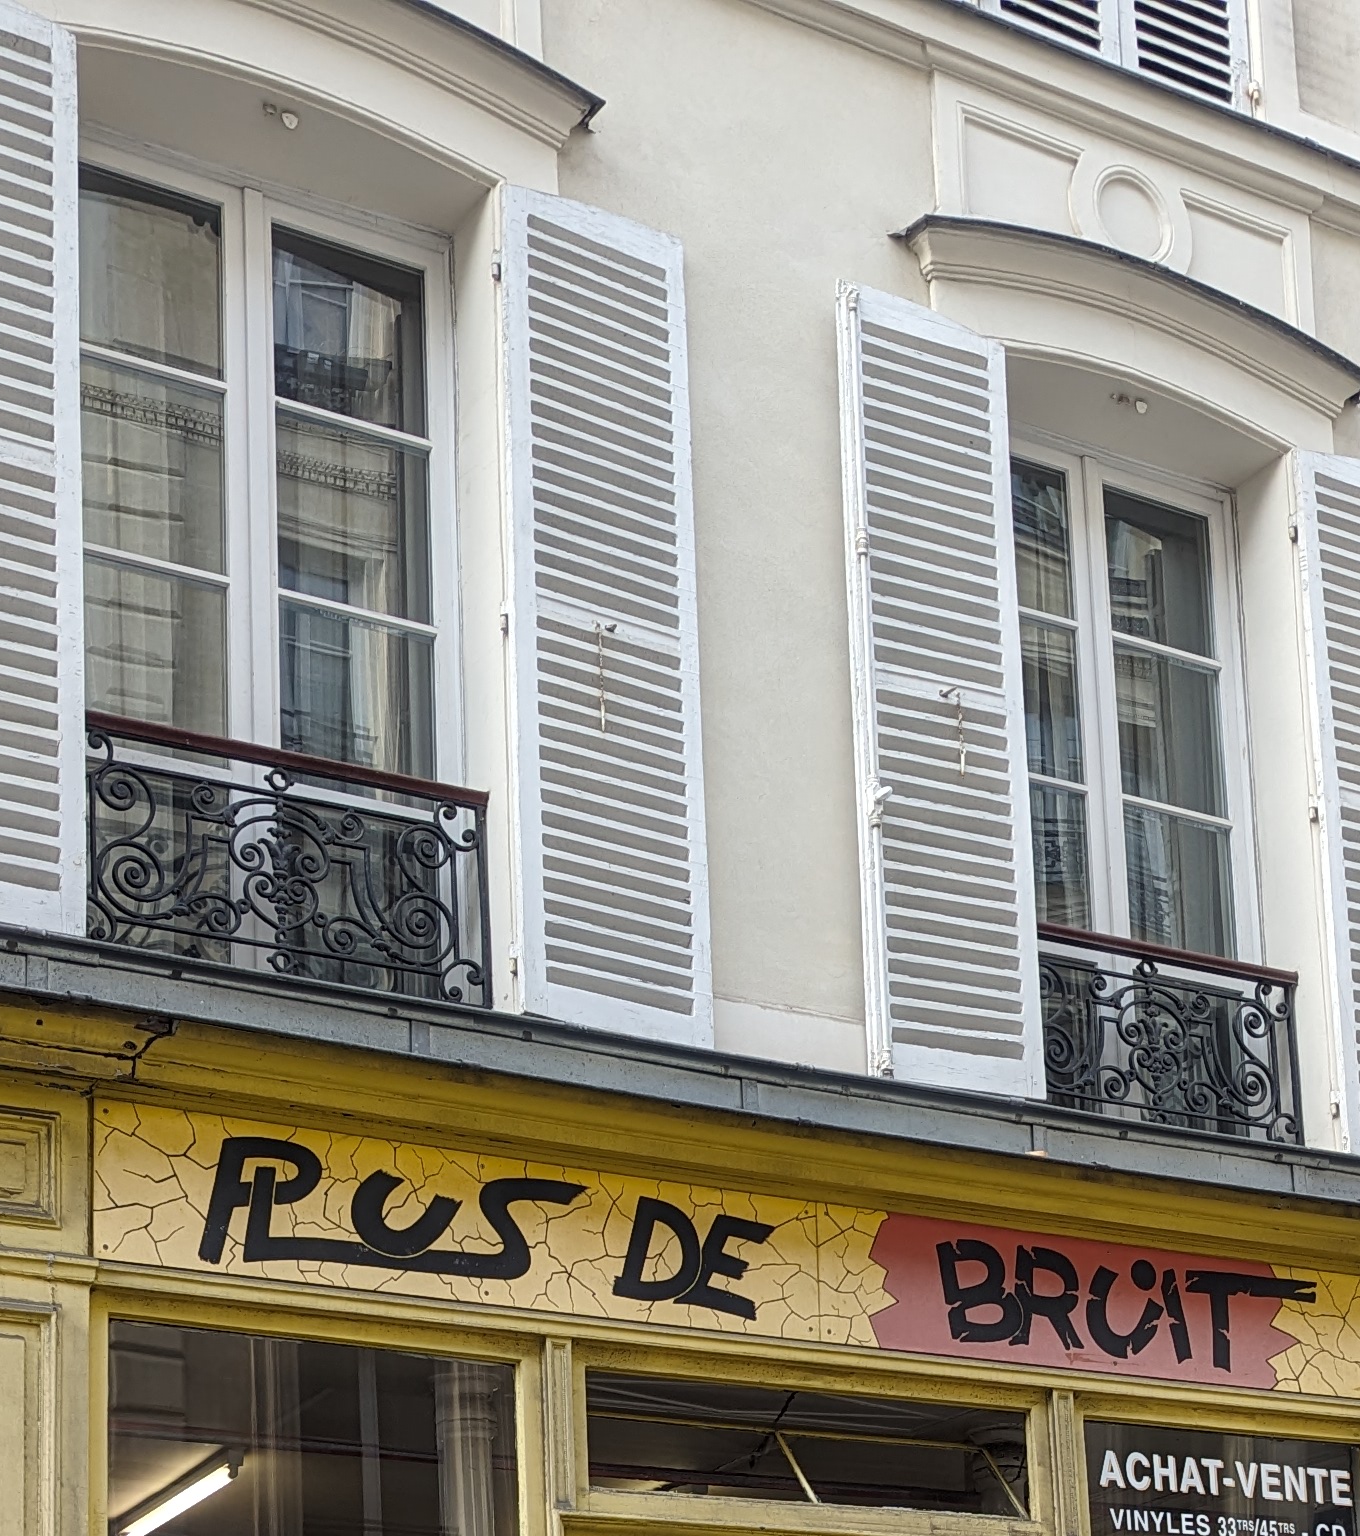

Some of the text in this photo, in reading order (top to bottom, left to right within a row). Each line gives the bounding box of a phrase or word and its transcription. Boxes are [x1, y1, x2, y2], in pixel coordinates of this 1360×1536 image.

[198, 1136, 1317, 1372] PLUS DE BRUIT
[1099, 1450, 1353, 1507] ACHAT-VENTE
[1109, 1508, 1210, 1536] VINYLES
